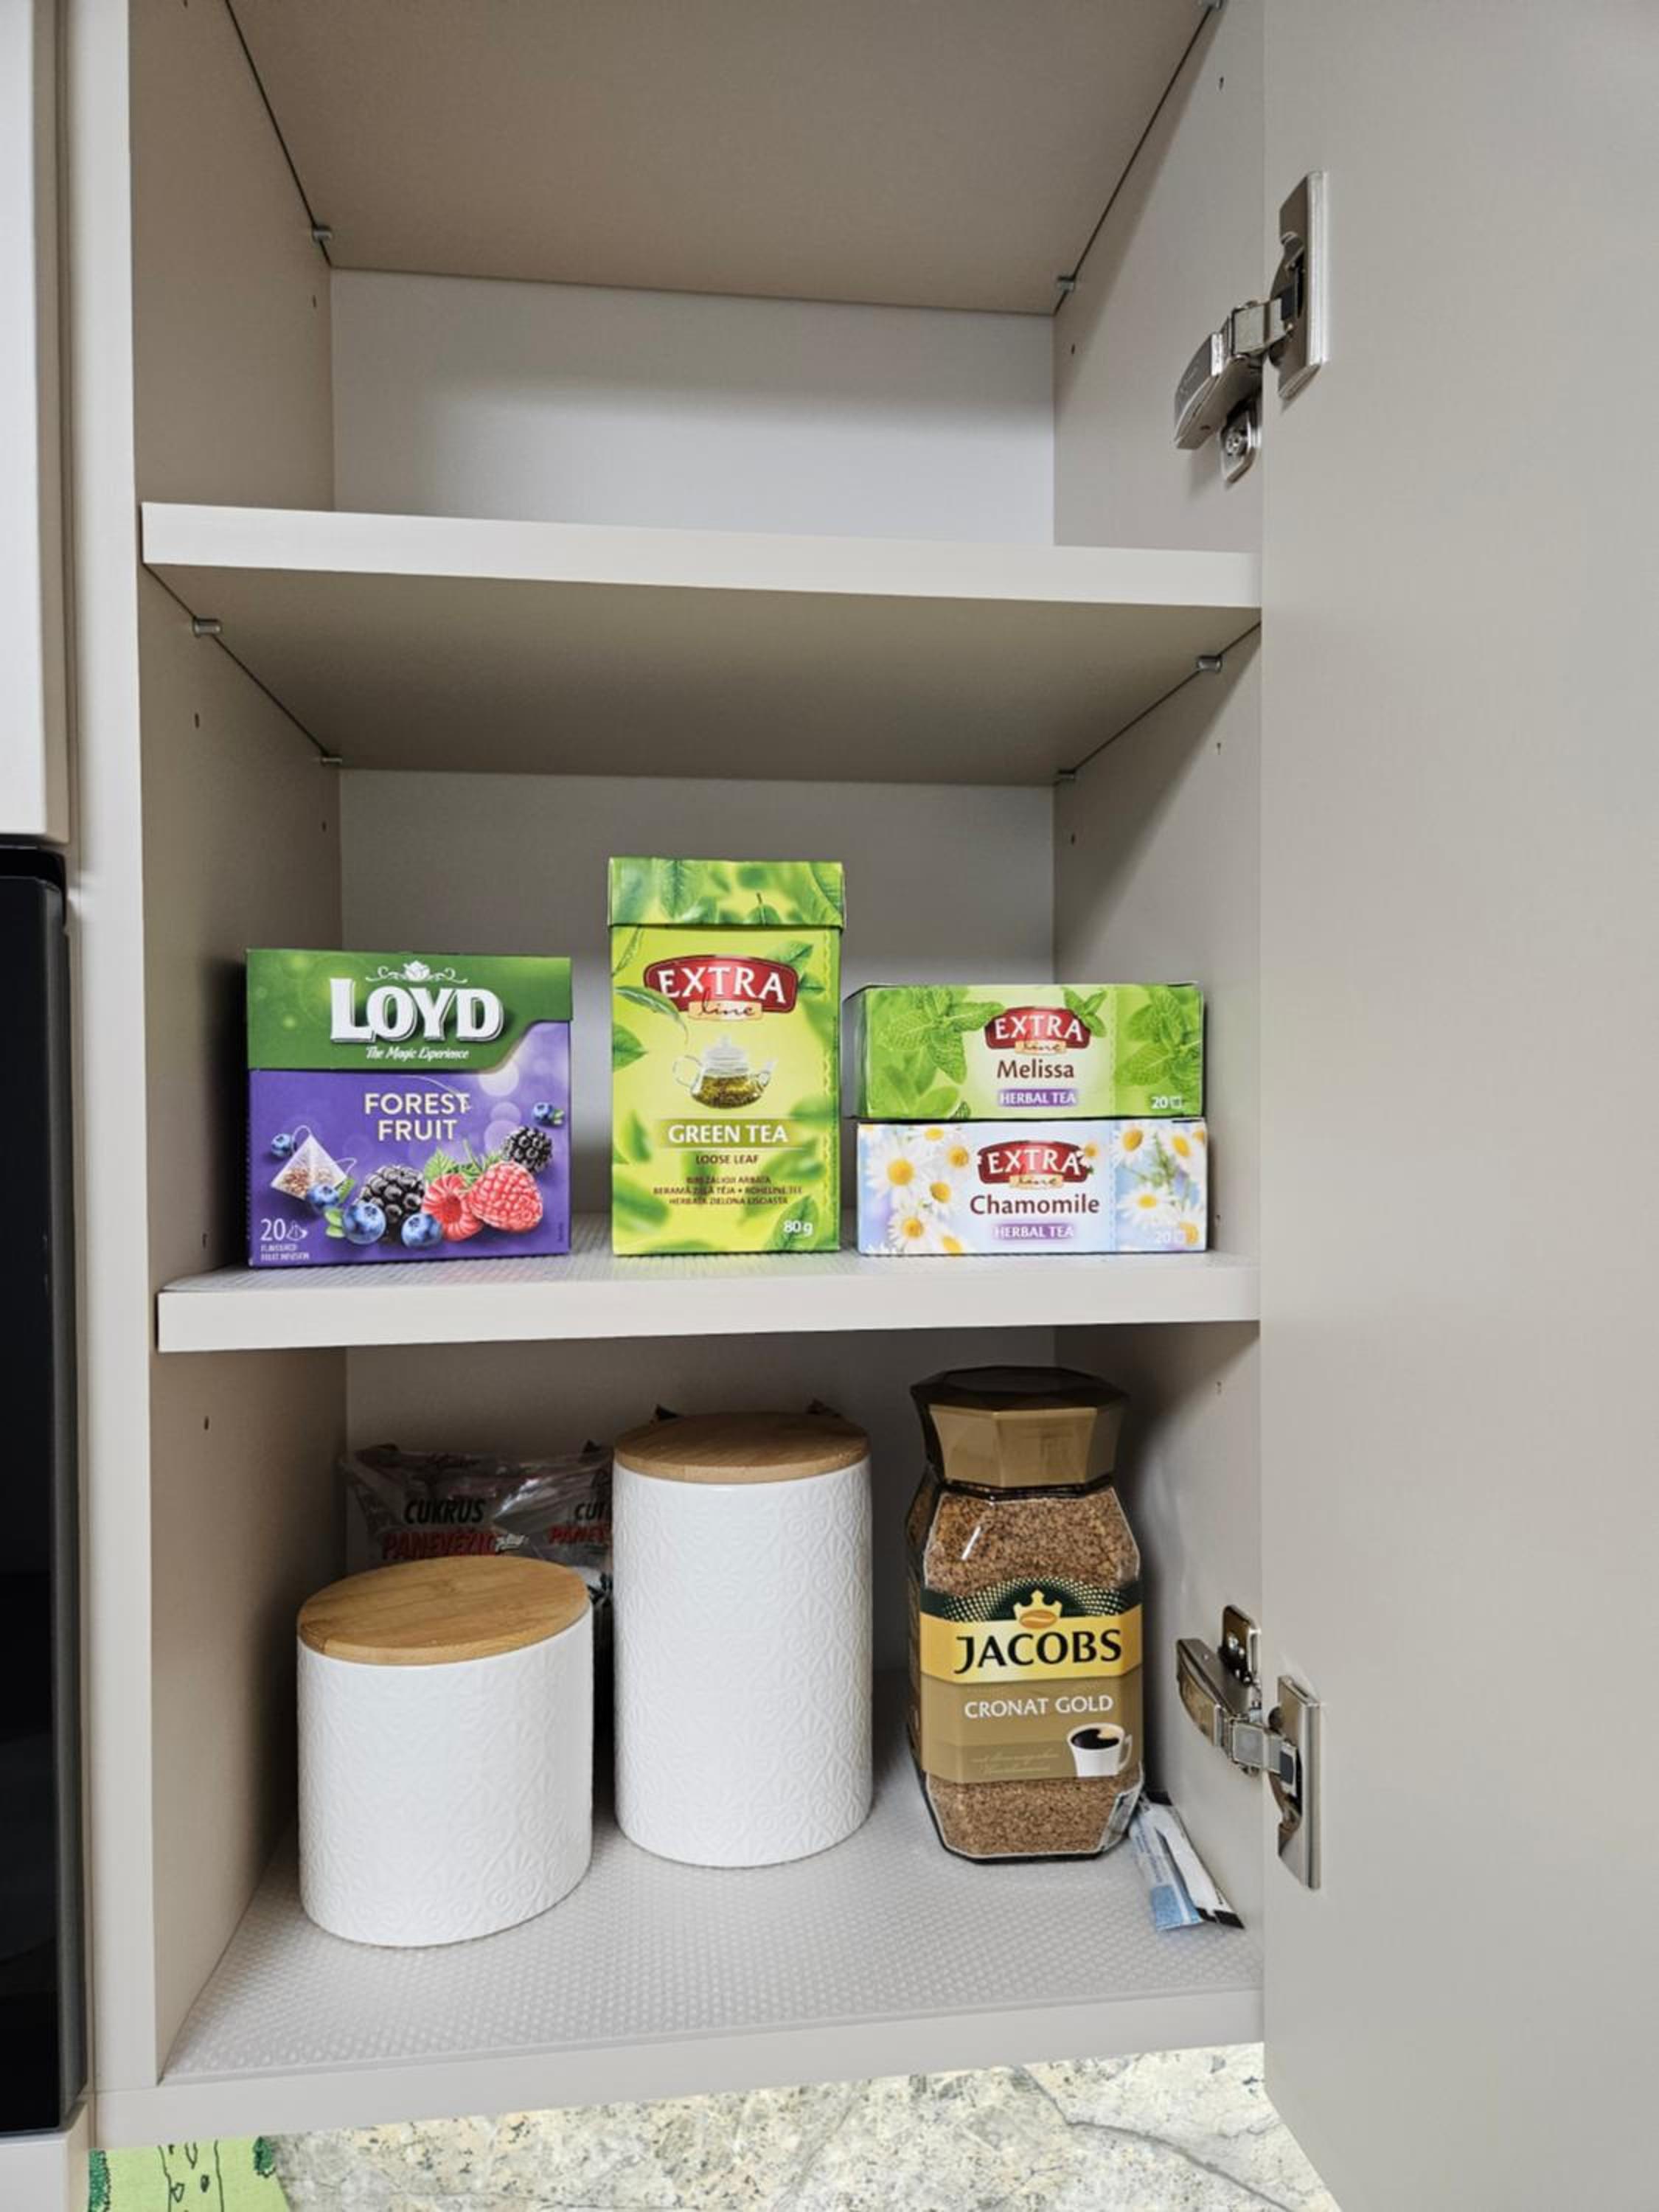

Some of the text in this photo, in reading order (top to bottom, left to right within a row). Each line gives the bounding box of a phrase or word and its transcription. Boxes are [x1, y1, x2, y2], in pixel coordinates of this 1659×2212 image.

[658, 966, 787, 1004] EXTRA
[330, 978, 504, 1043] LOYD
[699, 988, 755, 1016] line
[995, 1014, 1083, 1042] EXTRA
[997, 1058, 1074, 1079] Melissa
[364, 1093, 470, 1115] FOREST
[1000, 1092, 1076, 1105] HERBAL TEA
[1151, 1096, 1168, 1110] 20
[378, 1119, 458, 1141] FRUIT
[668, 1123, 788, 1144] GREEN TEA
[696, 1155, 759, 1165] LOOSE LEAF
[987, 1149, 1081, 1175] EXTRA
[970, 1193, 1100, 1215] Chamomile
[260, 1217, 286, 1241] 20
[784, 1220, 813, 1237] 80 g
[995, 1225, 1074, 1238] HERBAL TEA
[404, 1498, 487, 1524] CUKRUS
[954, 1628, 1122, 1674] JACOBS
[964, 1695, 1113, 1719] CRONAT GOLD
